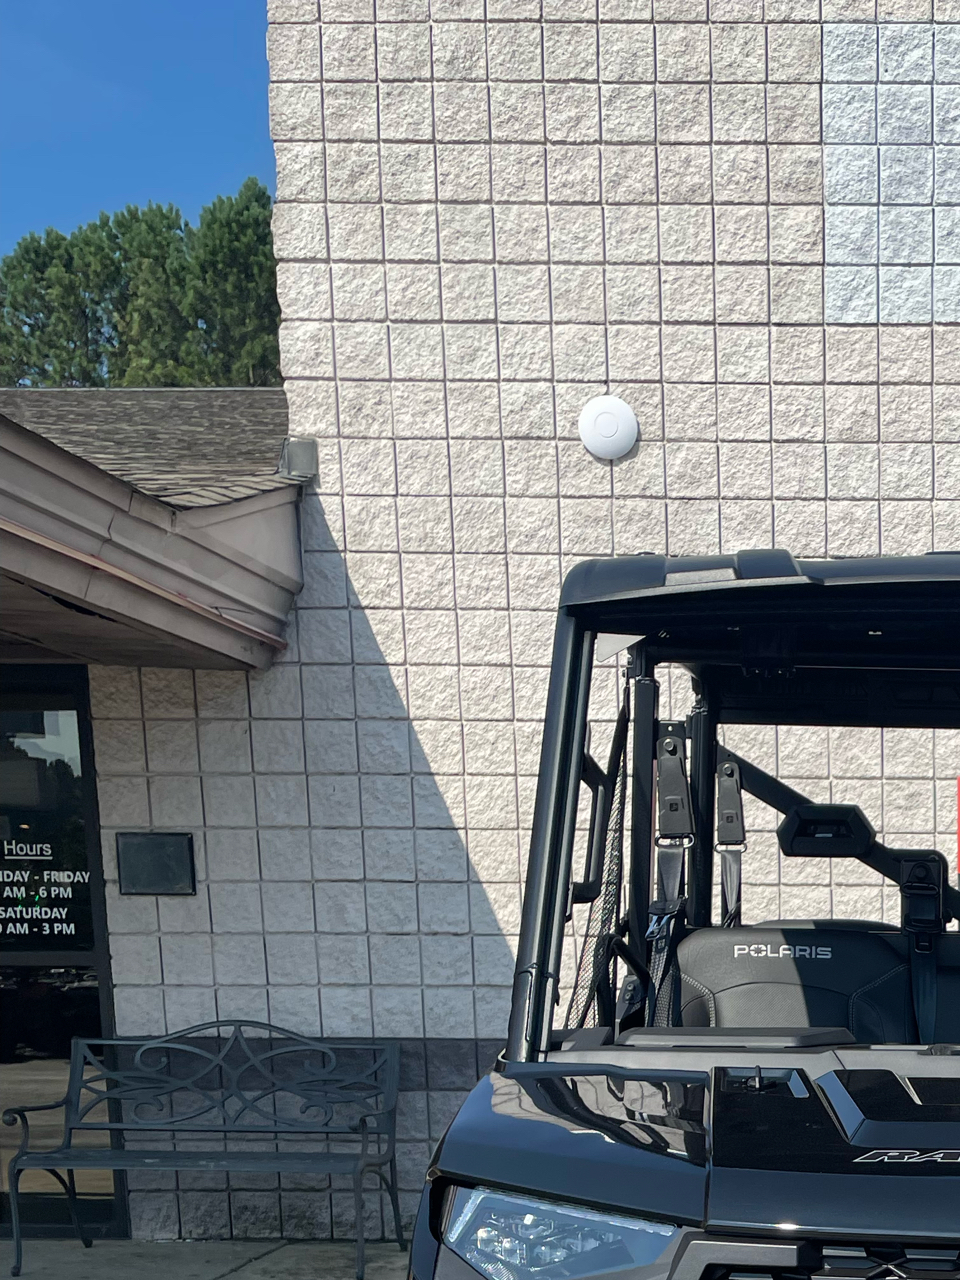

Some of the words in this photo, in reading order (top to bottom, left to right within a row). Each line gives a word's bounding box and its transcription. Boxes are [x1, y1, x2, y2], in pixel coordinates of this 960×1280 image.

[3, 840, 52, 856] Hours
[43, 870, 90, 883] FRIDAY
[3, 886, 26, 898] AM
[38, 886, 47, 899] 6
[50, 886, 73, 899] PM
[0, 907, 68, 919] SATURDAY
[6, 922, 29, 935] AM
[42, 922, 50, 935] 3
[53, 923, 76, 935] PM
[733, 944, 832, 959] POLARIS
